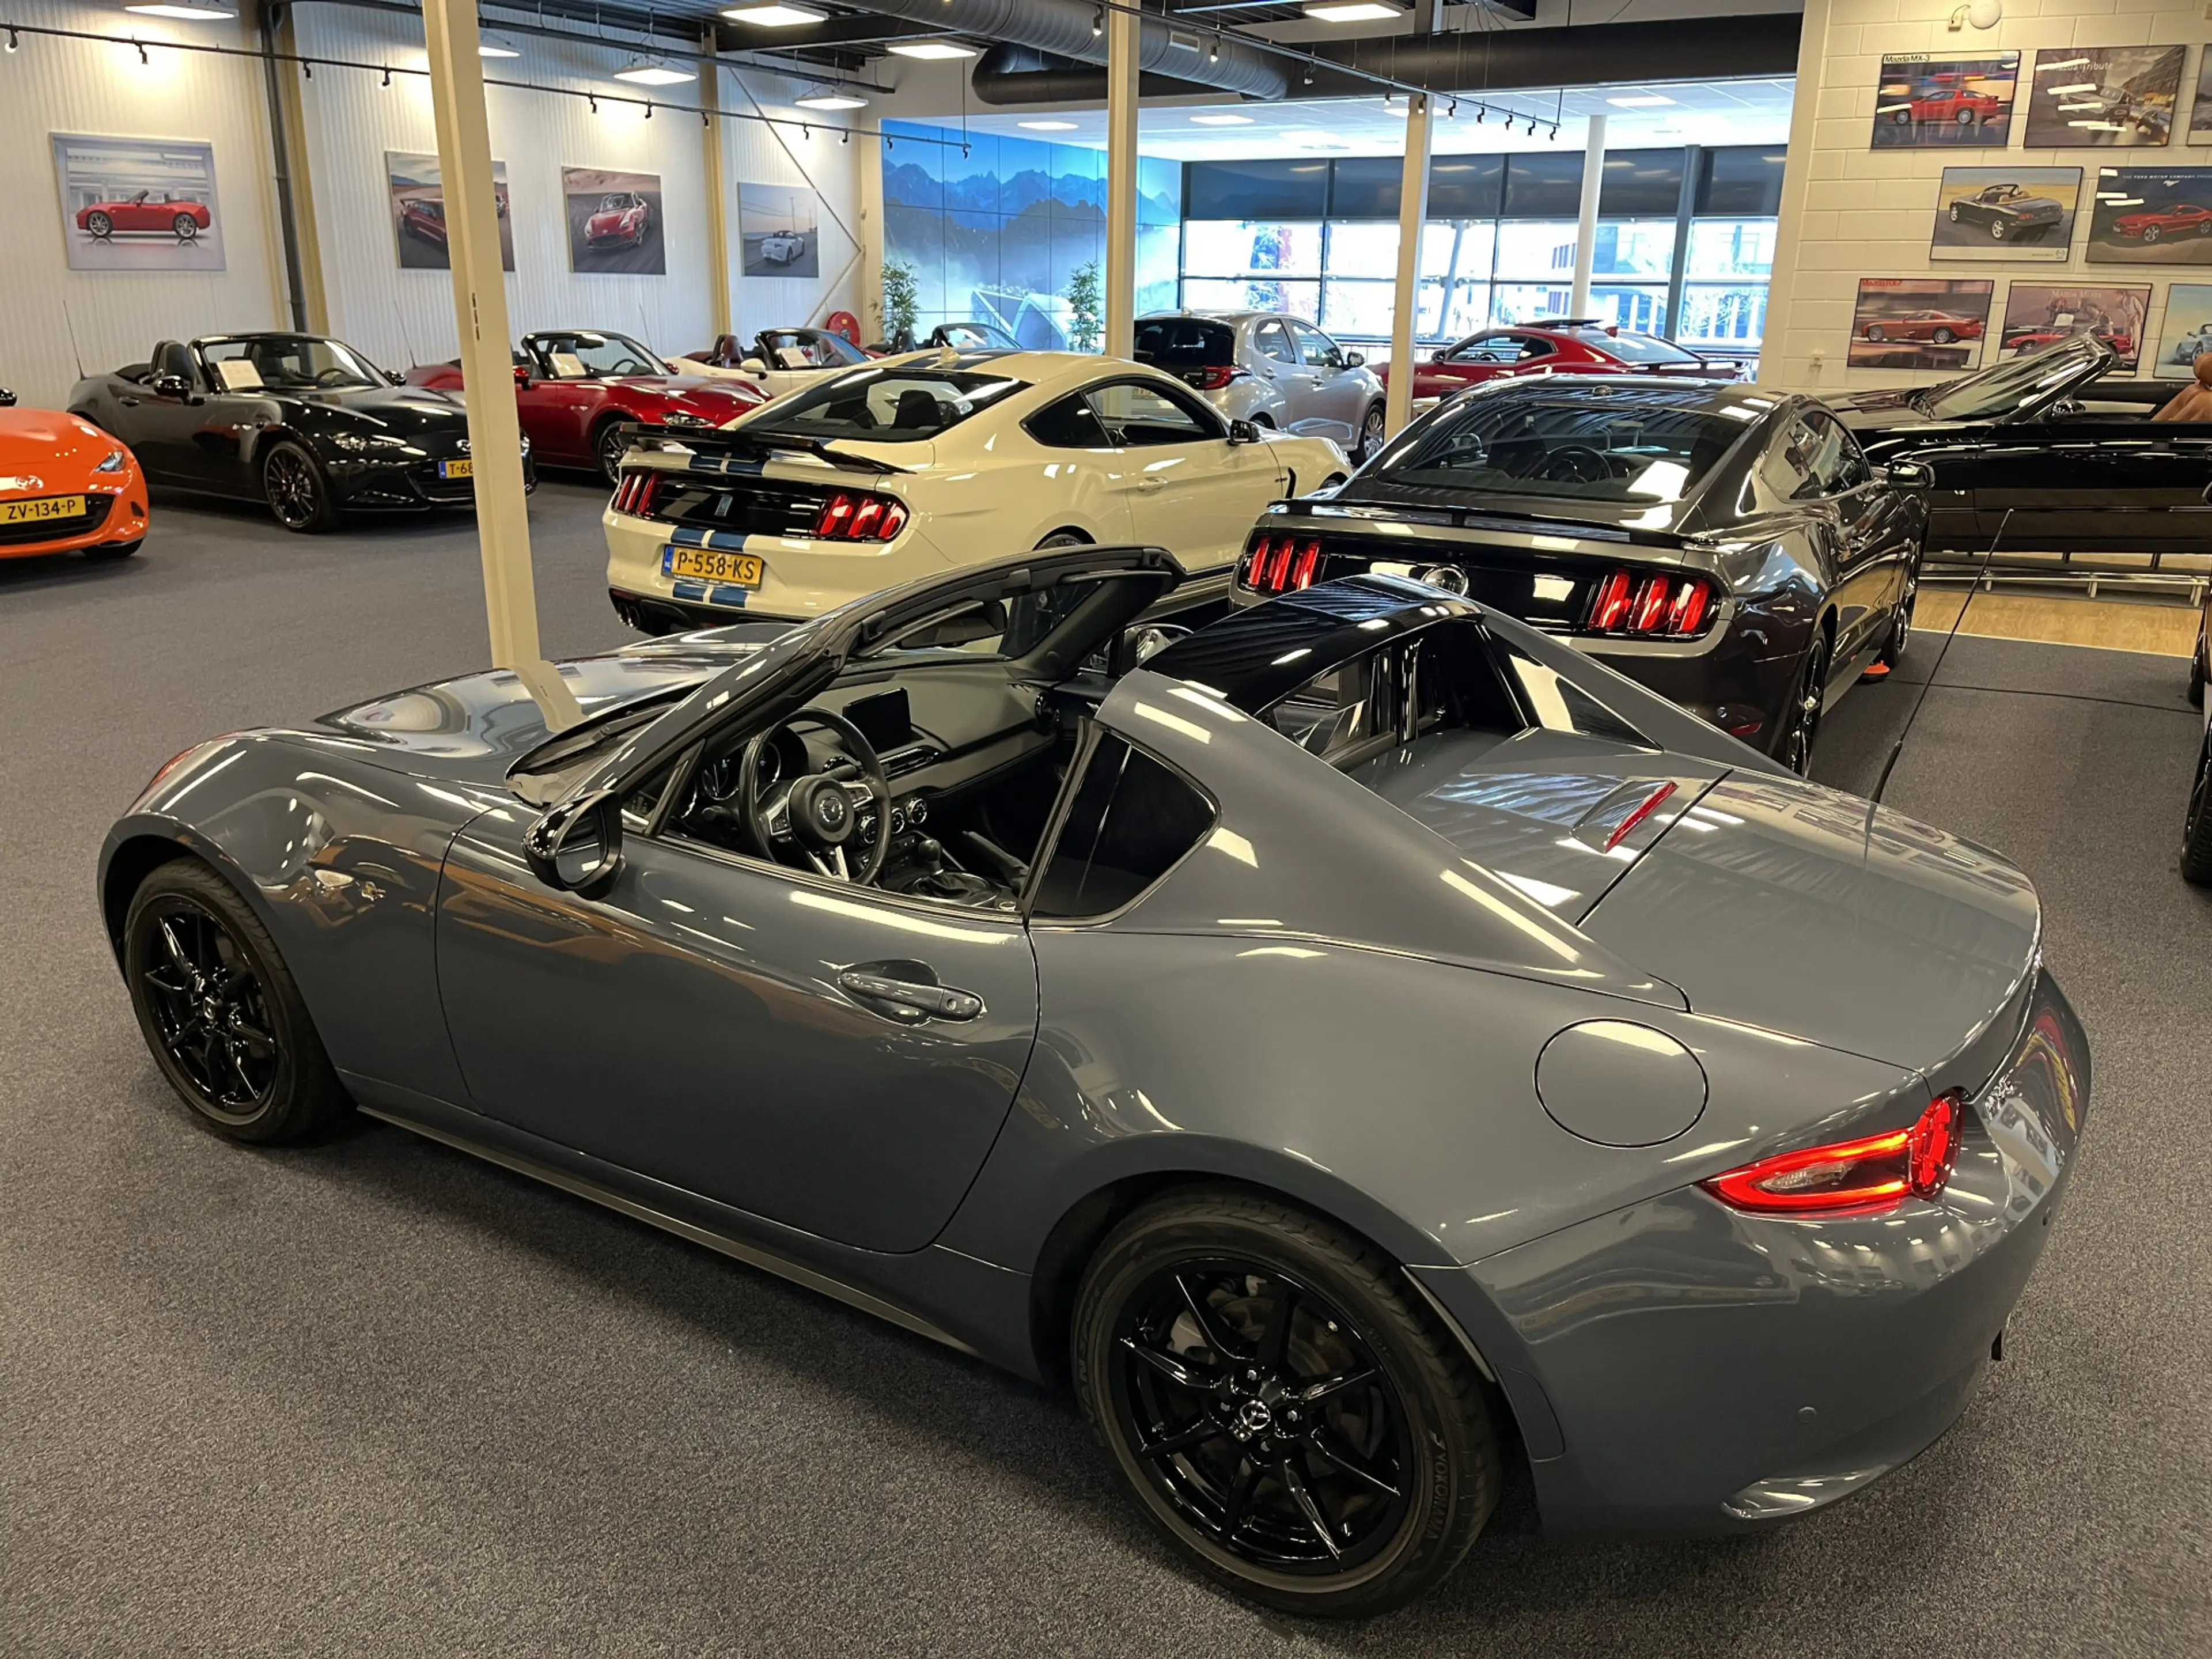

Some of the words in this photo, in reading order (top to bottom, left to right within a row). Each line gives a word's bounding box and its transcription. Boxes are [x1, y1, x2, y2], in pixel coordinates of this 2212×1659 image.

[2081, 62, 2114, 73] Tribute
[7, 499, 76, 520] ZV-134-P
[677, 551, 755, 580] P-558-KS
[1425, 1452, 1449, 1539] YOKOHAMA
